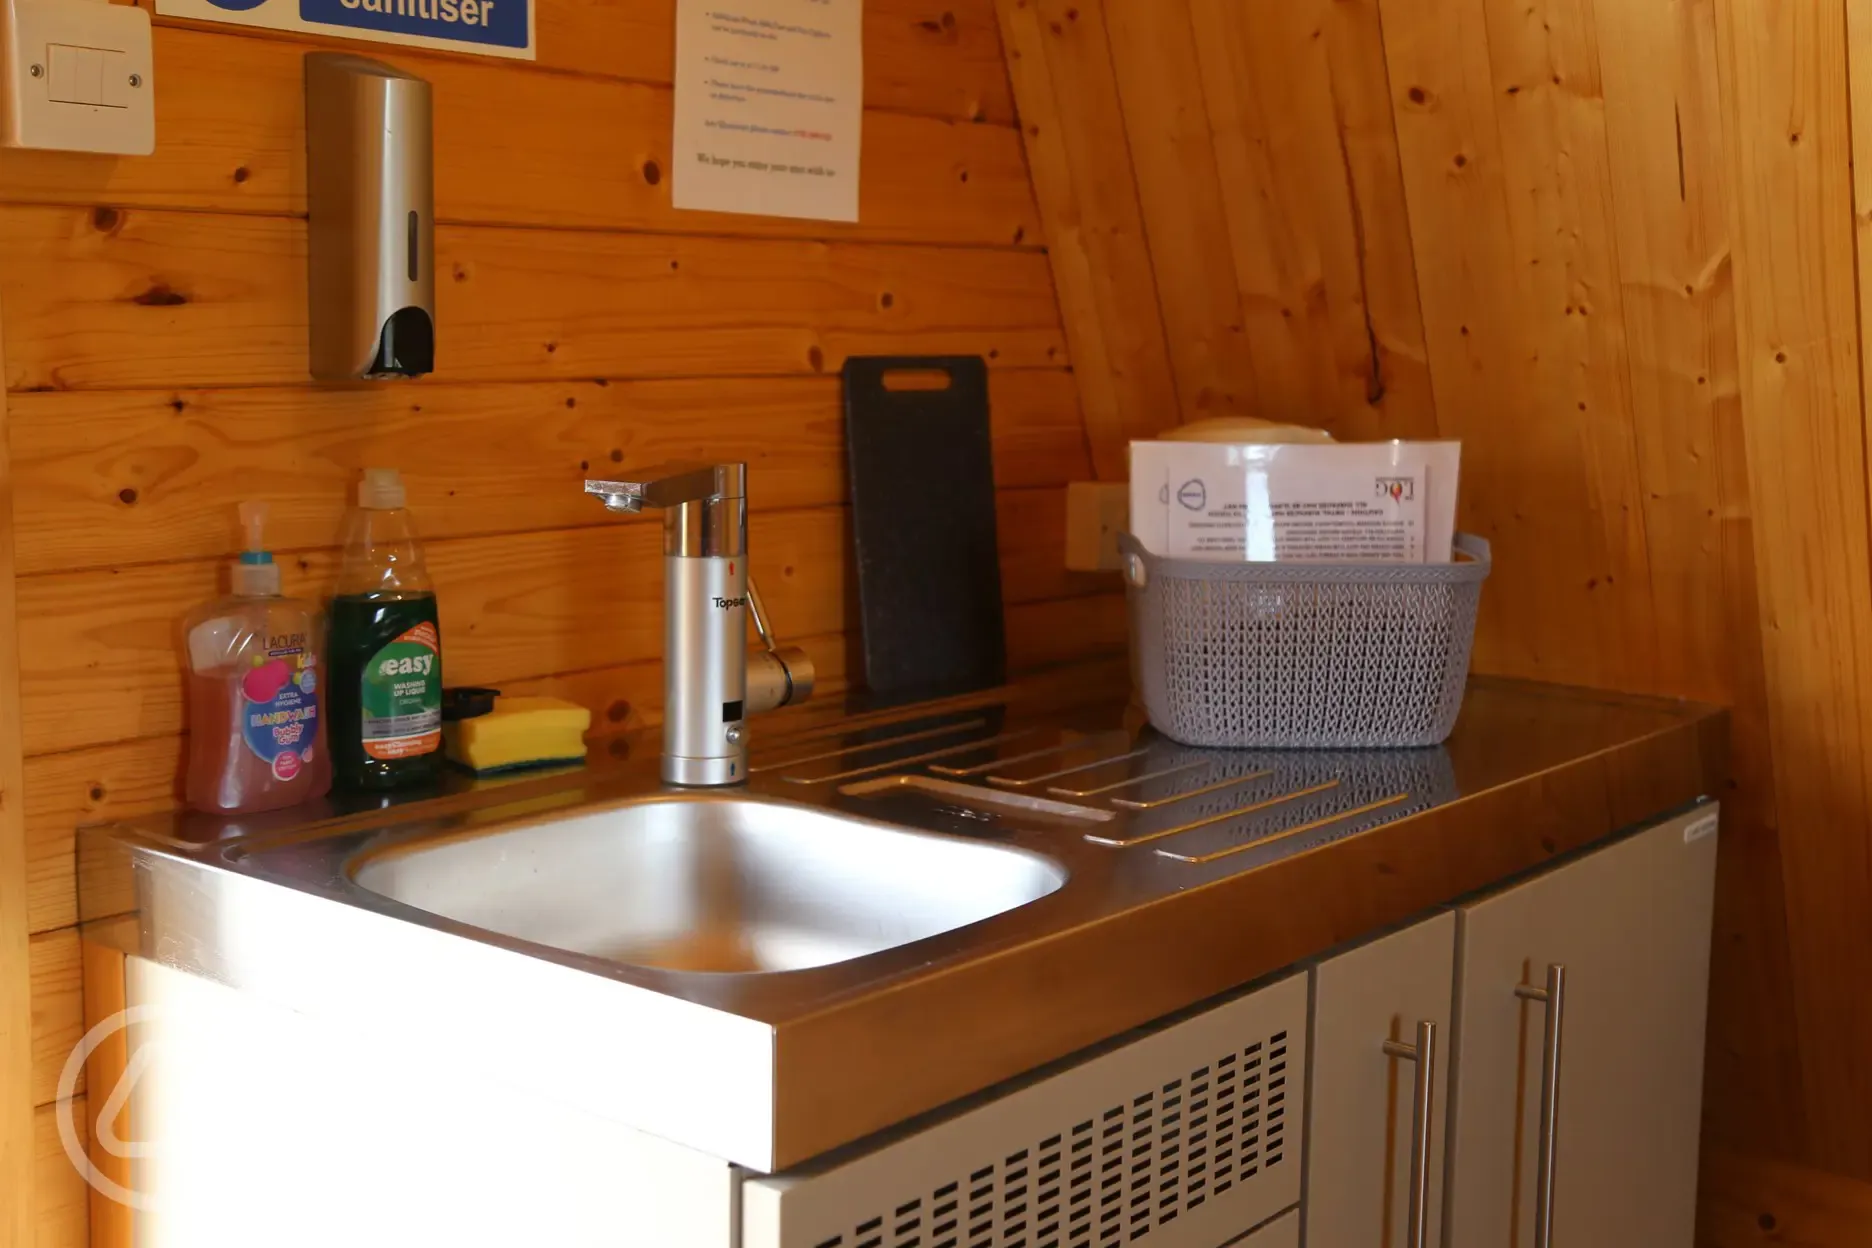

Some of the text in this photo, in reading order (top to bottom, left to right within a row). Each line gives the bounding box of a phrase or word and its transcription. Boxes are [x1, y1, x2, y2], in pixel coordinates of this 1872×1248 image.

[339, 0, 494, 27] nitiser
[262, 633, 306, 650] LACURA
[381, 653, 434, 676] easy
[393, 680, 426, 690] WASHING
[393, 686, 426, 697] UP LIQUID
[250, 705, 317, 727] HANDWASH
[272, 722, 304, 737] Bubbly
[278, 734, 300, 745] Gum
